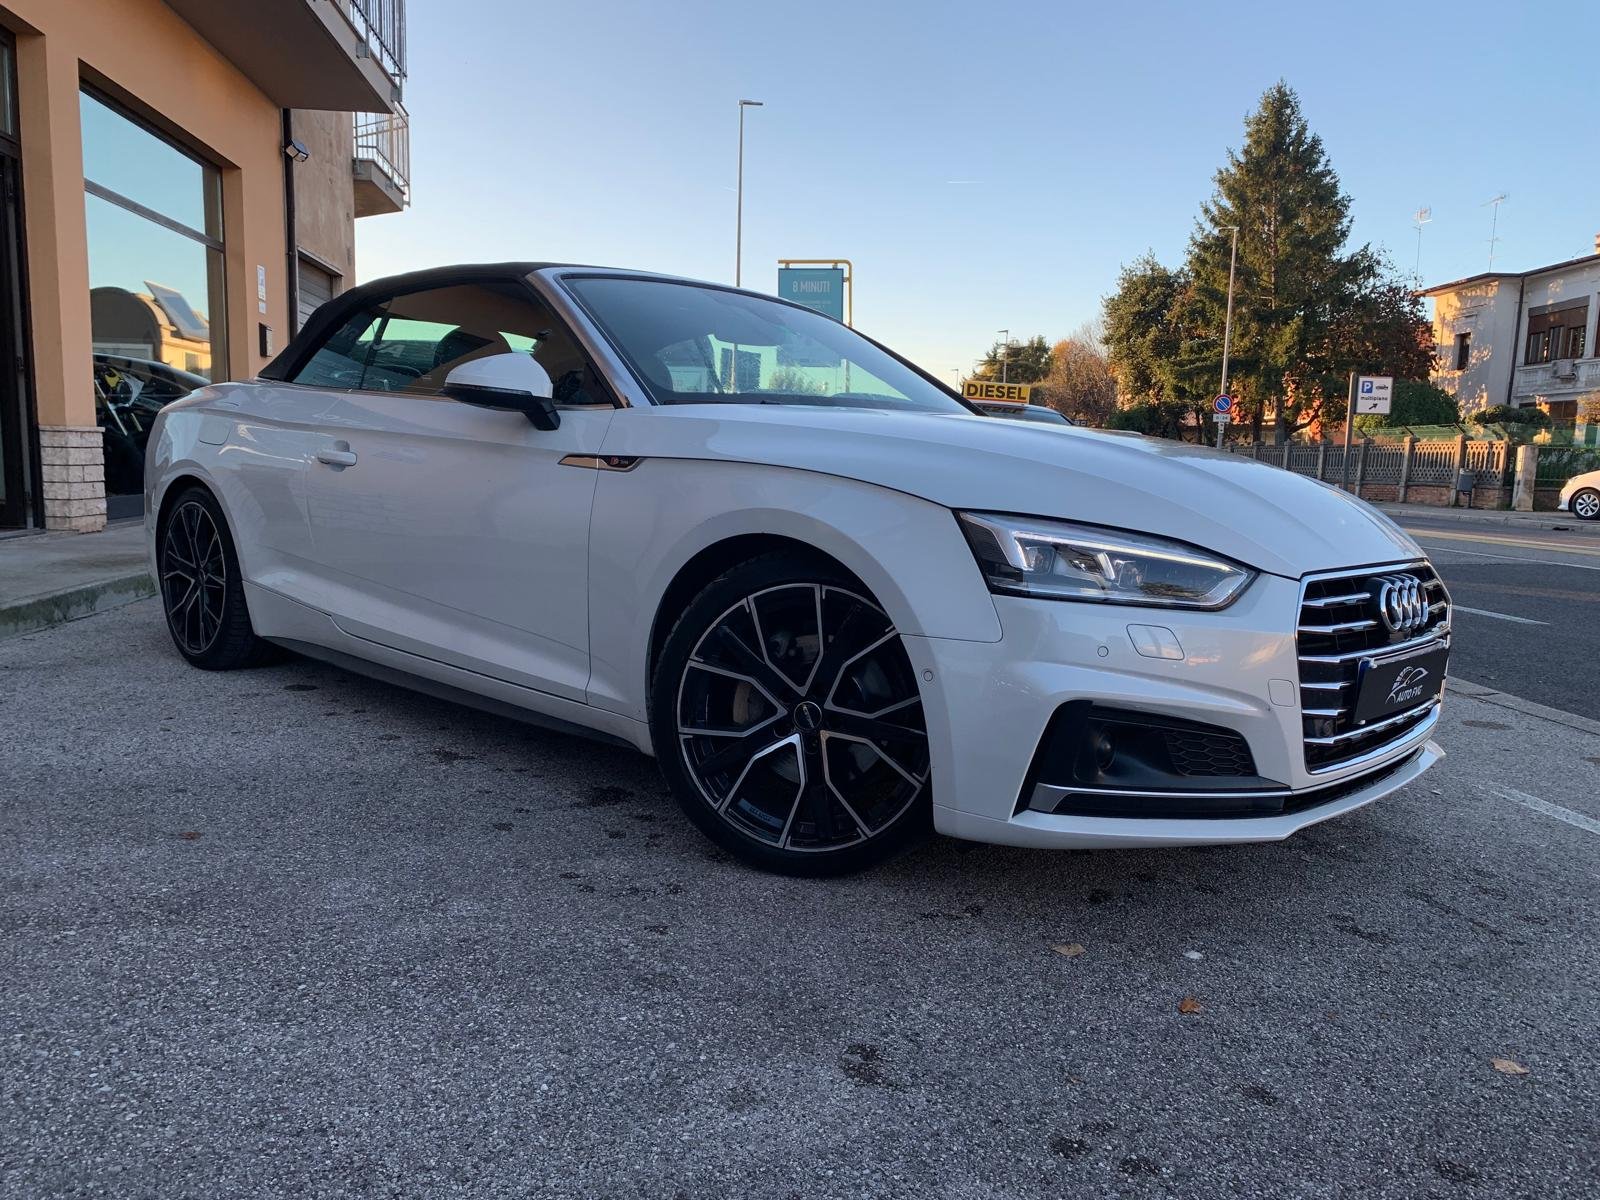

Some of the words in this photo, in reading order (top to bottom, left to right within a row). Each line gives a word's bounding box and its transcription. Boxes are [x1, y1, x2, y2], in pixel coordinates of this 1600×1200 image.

[792, 280, 798, 293] 8
[800, 280, 830, 293] MINUTI
[967, 383, 1027, 400] DIESEL
